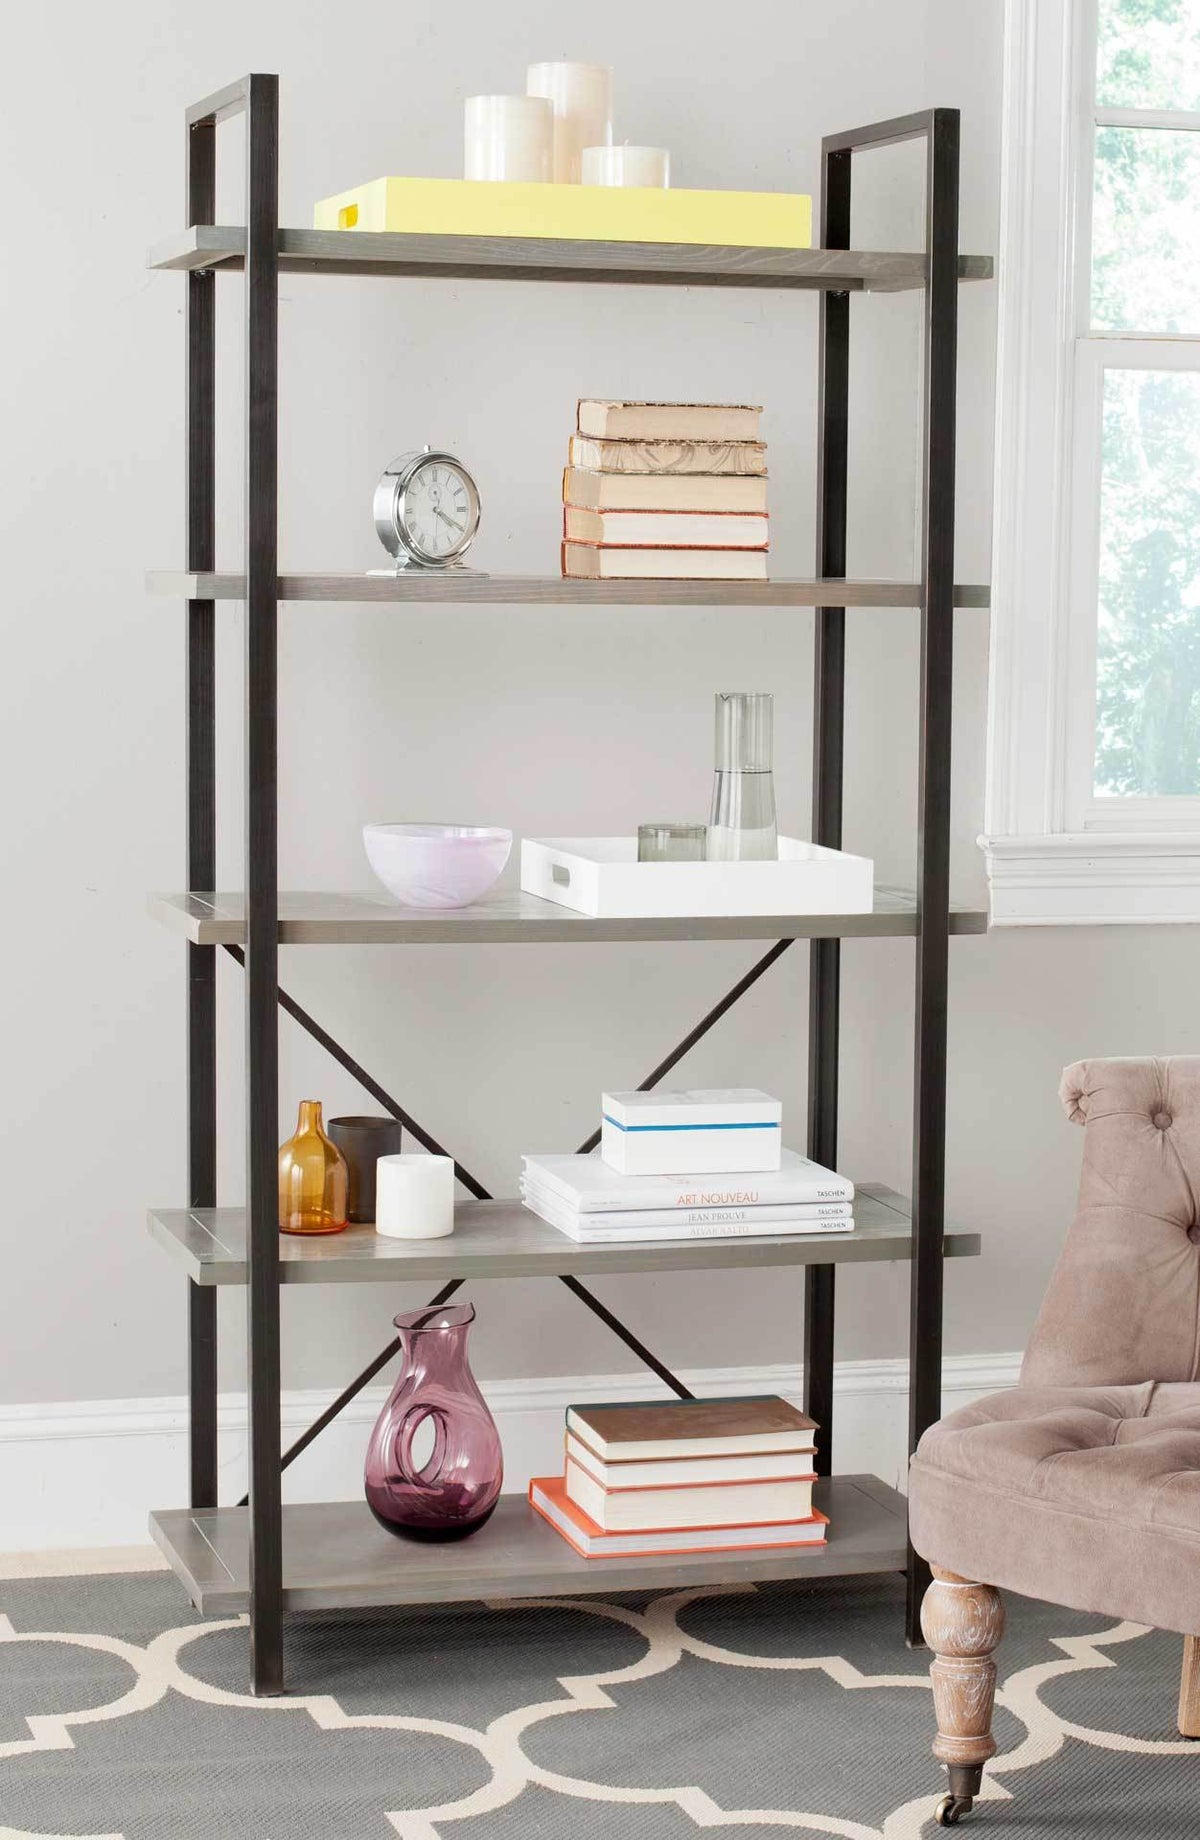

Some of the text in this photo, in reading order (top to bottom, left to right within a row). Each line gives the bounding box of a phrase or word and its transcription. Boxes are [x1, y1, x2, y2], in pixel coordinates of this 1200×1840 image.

[678, 1192, 759, 1205] ART NOUVEAU
[817, 1189, 845, 1197] TASCHEN
[688, 1212, 710, 1223] JEAN
